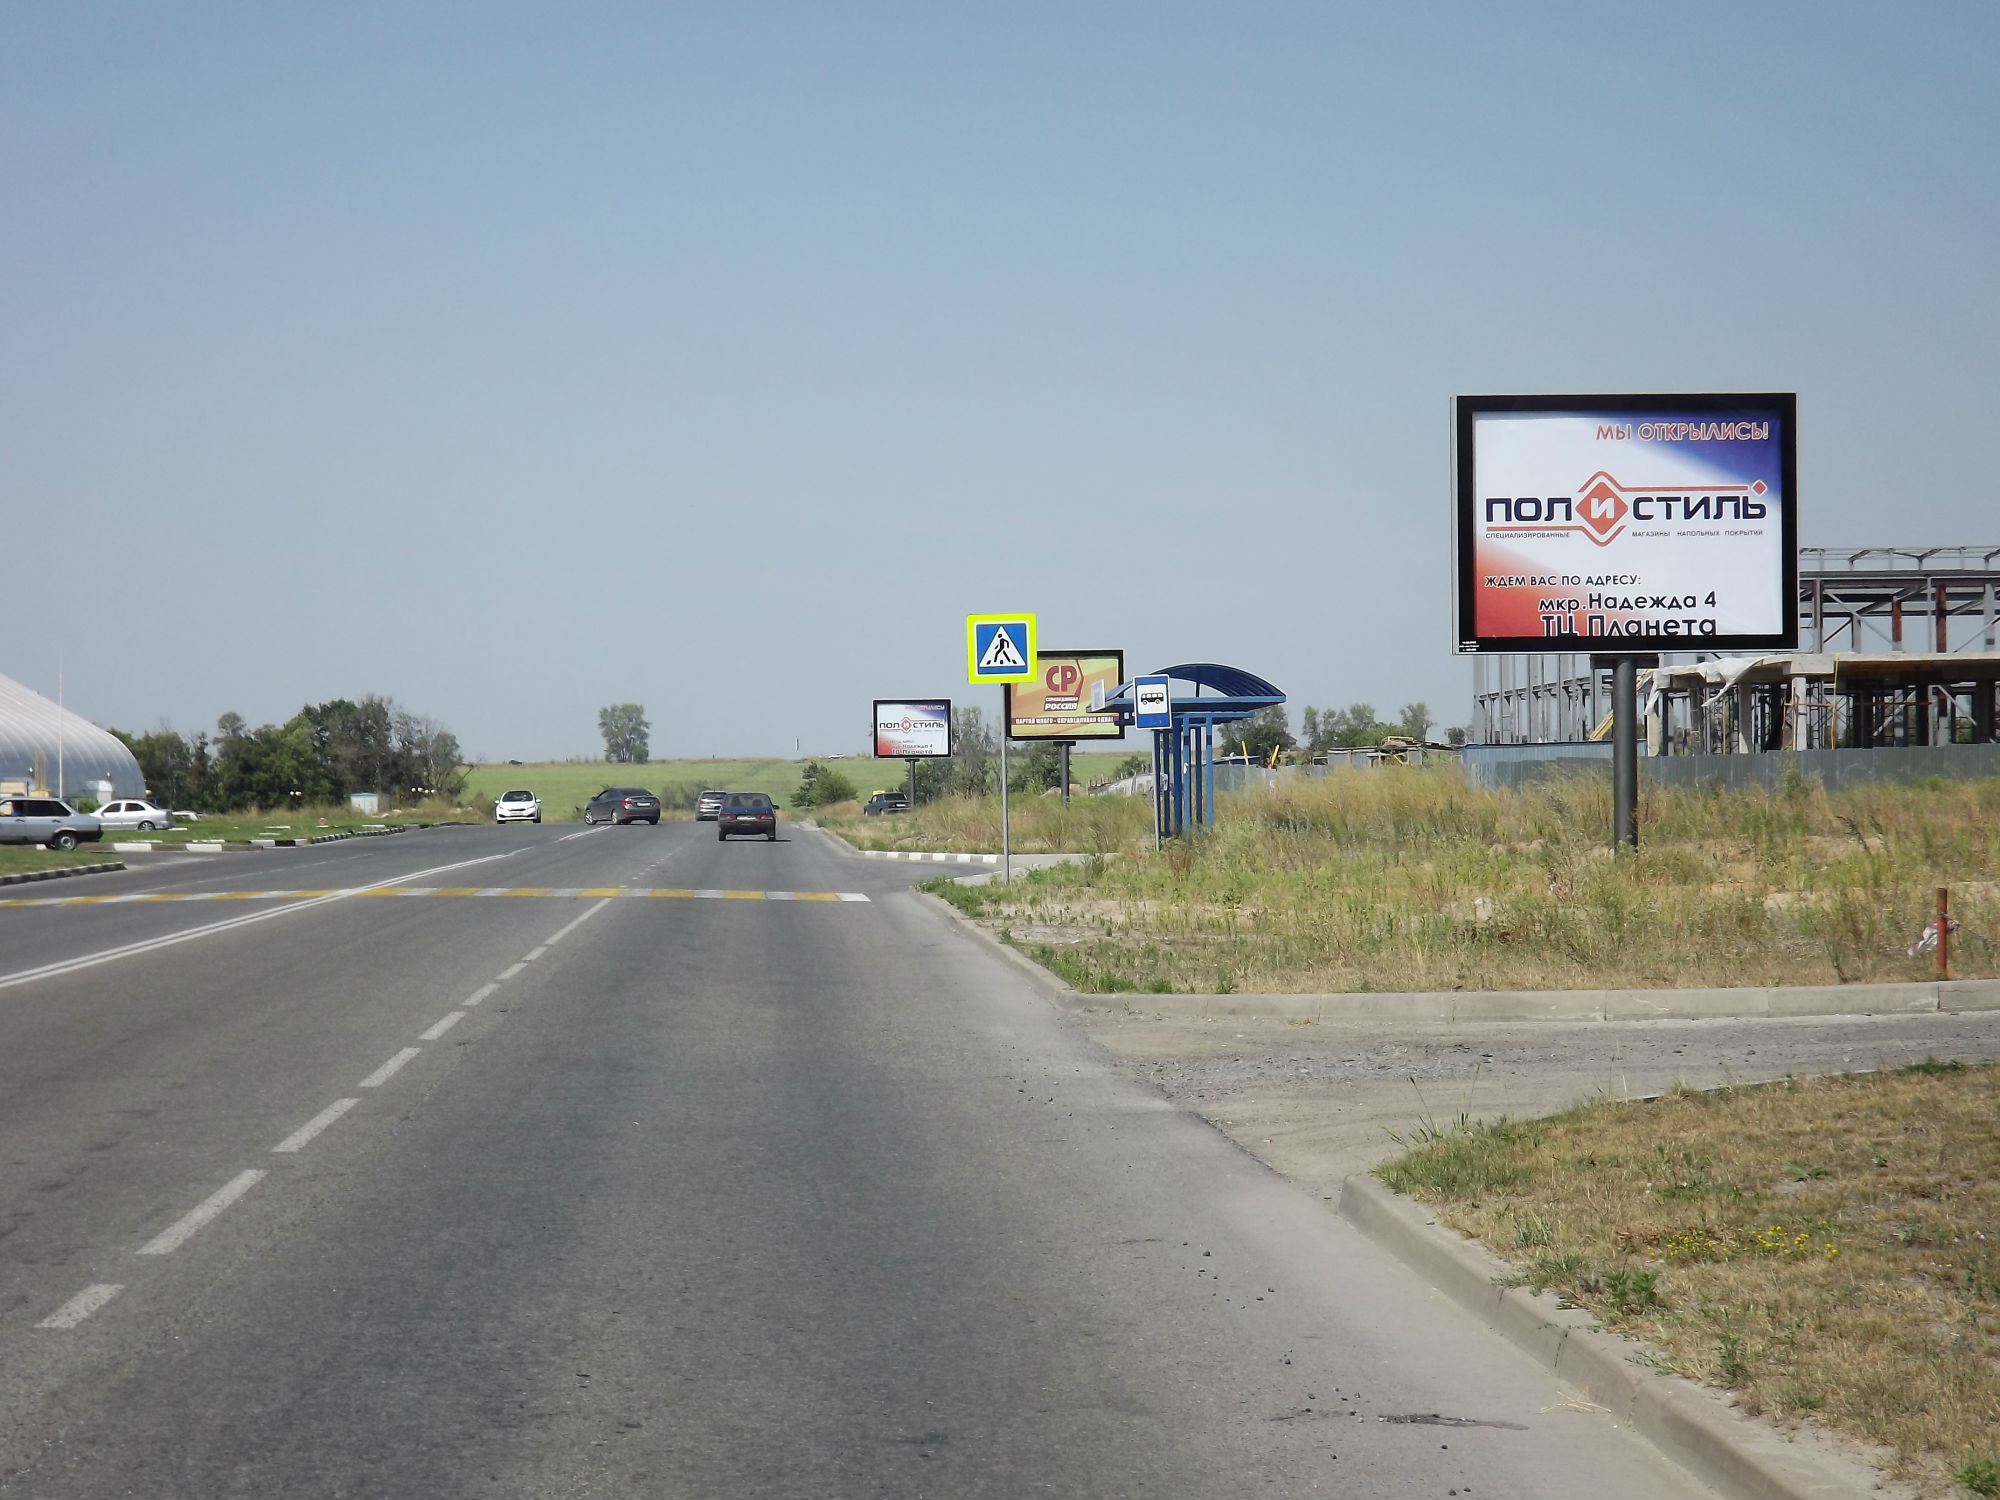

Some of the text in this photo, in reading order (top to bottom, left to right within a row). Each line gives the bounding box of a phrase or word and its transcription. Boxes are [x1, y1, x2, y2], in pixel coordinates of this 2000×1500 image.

[1596, 422, 1769, 441] МЫ ОТКРЫЛИСЬ!
[1485, 531, 1571, 539] СПЕЦИАЛИЗИРОВАННЫЕ
[1485, 575, 1641, 587] ЖДЕМ ВАС ПО АДРЕСУ:
[1704, 591, 1717, 608] 4
[1541, 615, 1717, 637] ТЦ Планета
[1046, 665, 1078, 692] СР
